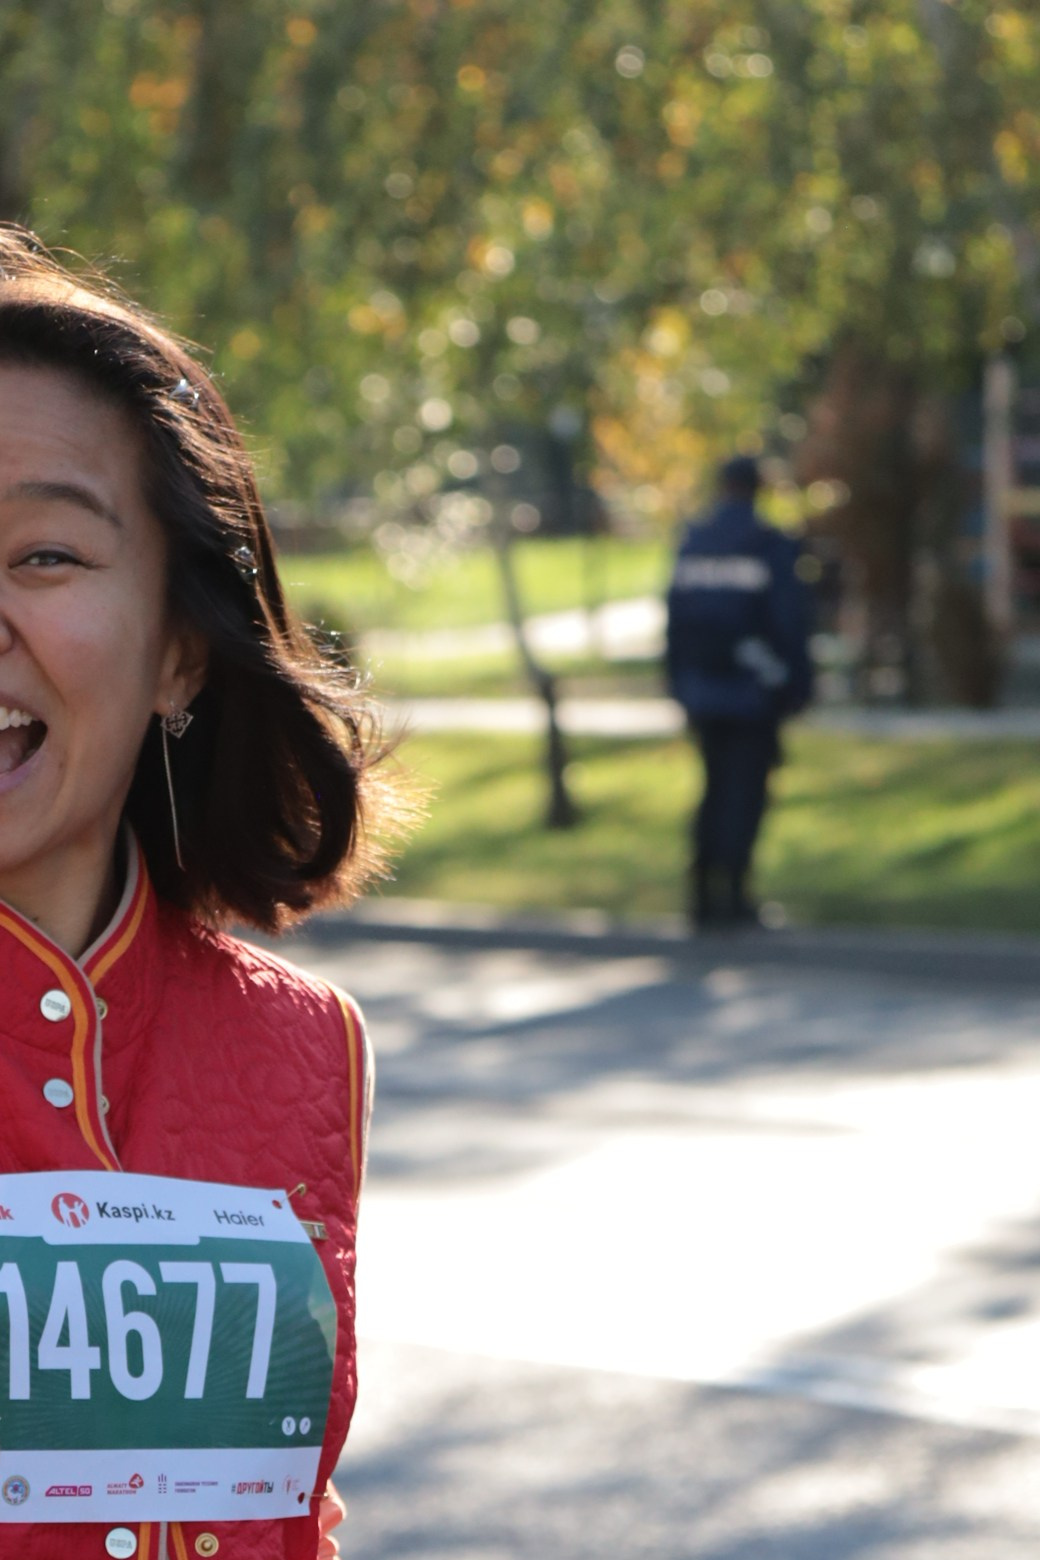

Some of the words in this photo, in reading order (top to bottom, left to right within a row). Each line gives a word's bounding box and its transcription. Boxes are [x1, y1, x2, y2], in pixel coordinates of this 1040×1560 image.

[96, 1201, 176, 1223] Kaspi.kz
[213, 1209, 265, 1227] Haier
[47, 1487, 76, 1495] ALTEL
